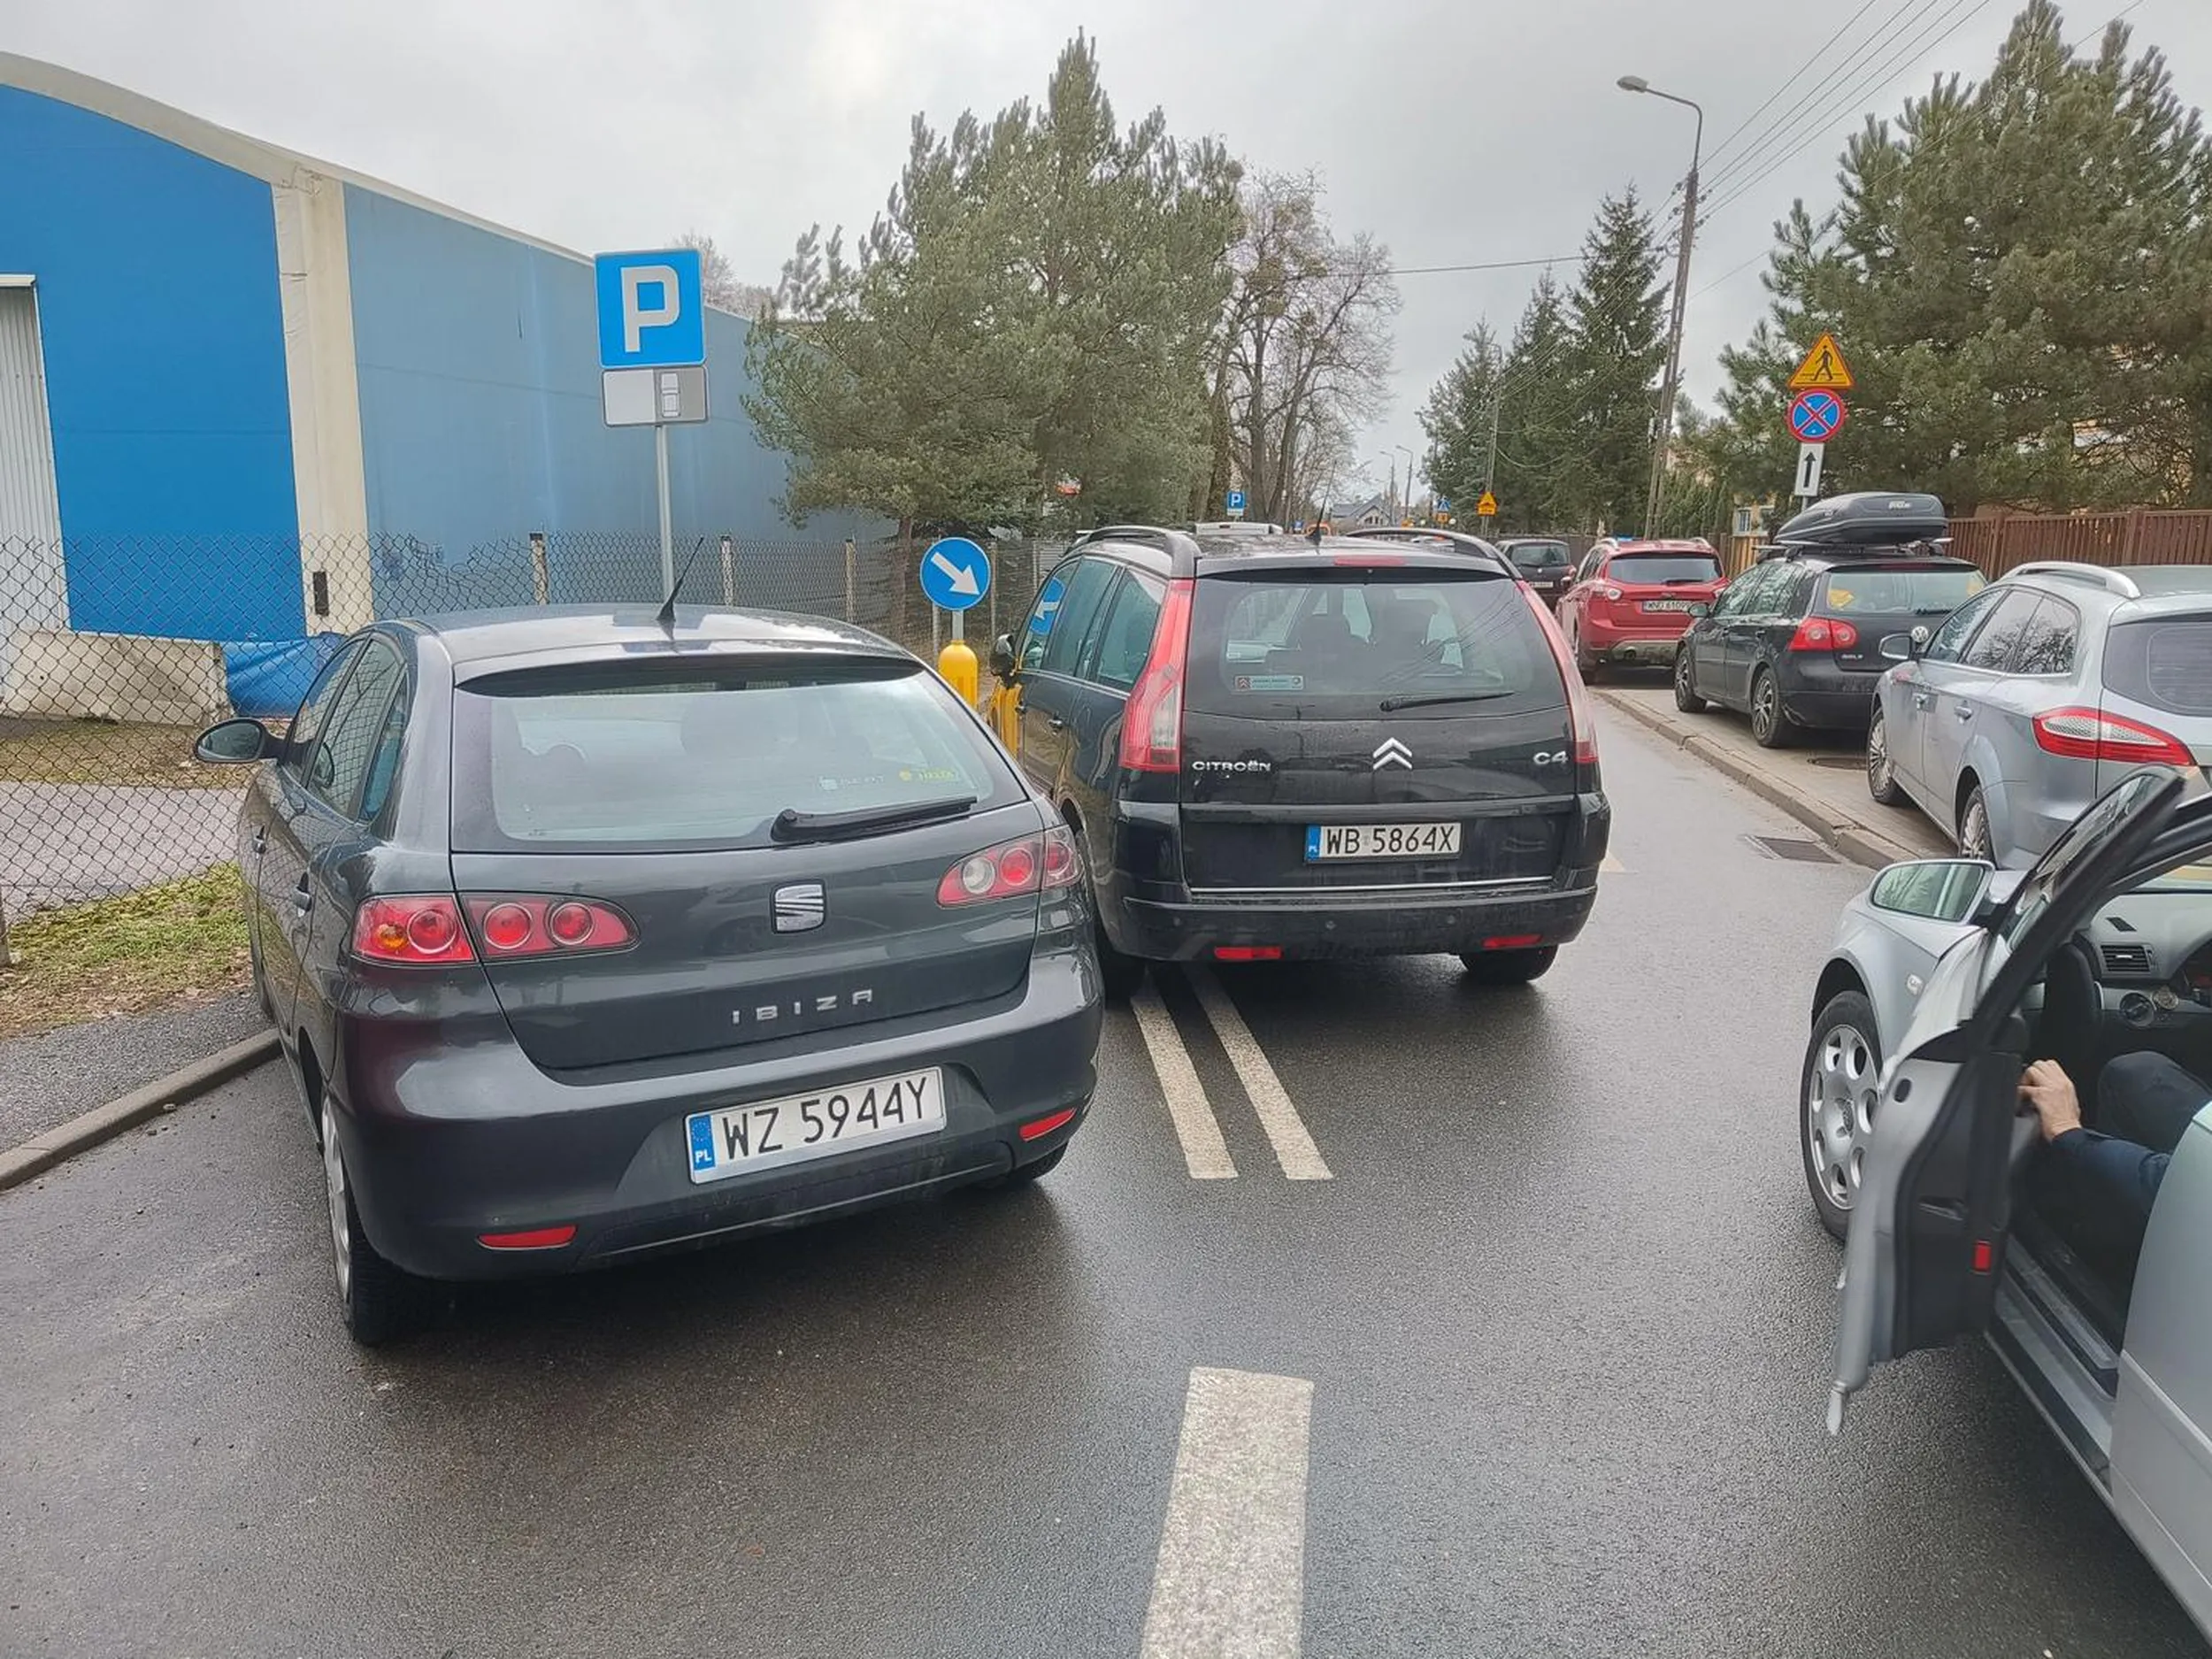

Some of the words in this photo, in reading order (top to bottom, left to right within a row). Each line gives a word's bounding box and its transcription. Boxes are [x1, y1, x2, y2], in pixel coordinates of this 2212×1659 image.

[621, 265, 680, 353] P
[1231, 493, 1241, 506] P
[1532, 750, 1568, 764] C4
[1327, 828, 1360, 854] WB
[1372, 826, 1454, 853] 5864X
[733, 989, 872, 1024] IBIZA
[723, 1107, 782, 1160] WZ
[800, 1077, 927, 1143] 5944Y
[695, 1151, 712, 1163] PL
